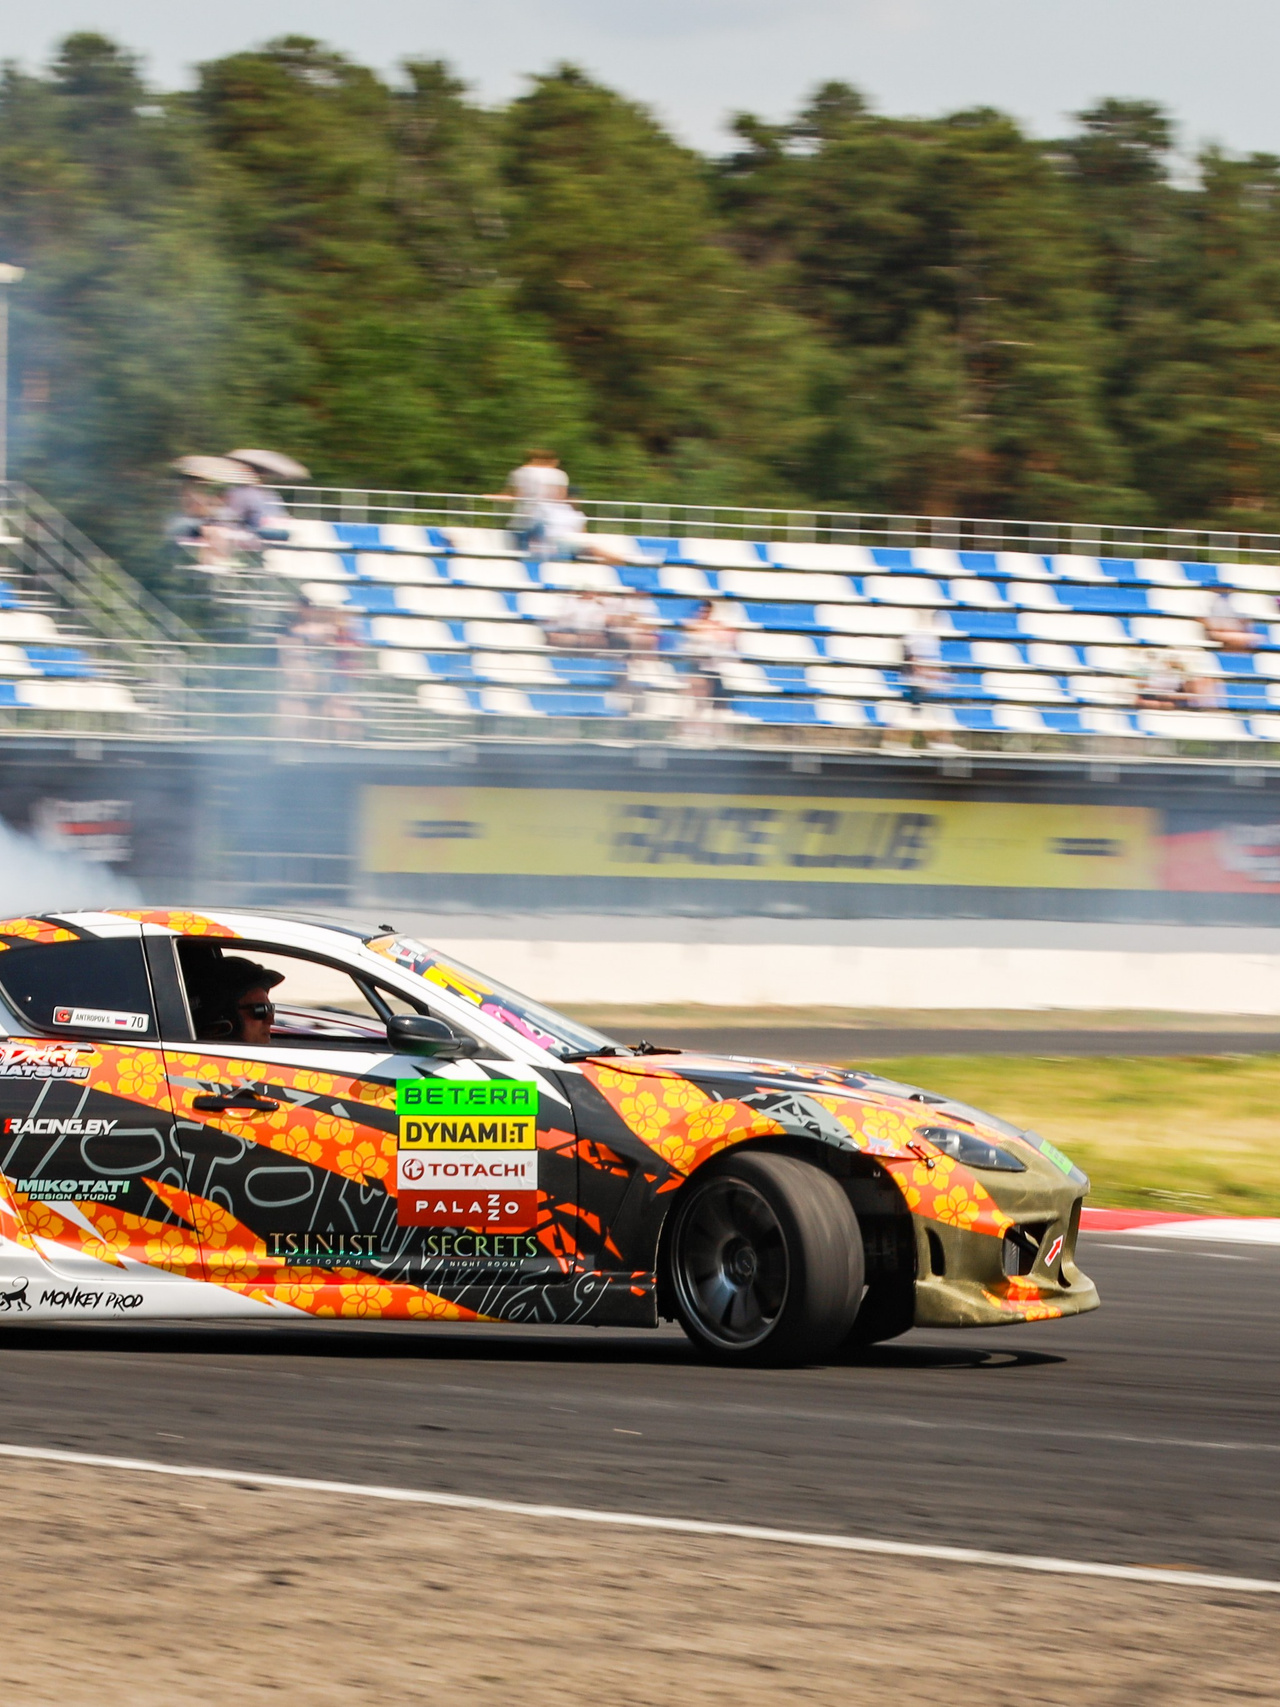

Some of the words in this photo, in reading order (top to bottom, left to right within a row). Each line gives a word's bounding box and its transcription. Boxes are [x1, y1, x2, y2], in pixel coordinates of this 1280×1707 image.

[608, 804, 782, 867] RACE
[786, 808, 940, 870] CLUB
[75, 1013, 107, 1023] ANTROPOV
[130, 1016, 144, 1029] 70
[428, 1163, 526, 1177] TOTACHI
[16, 1180, 130, 1194] MIKOTATI
[29, 1193, 72, 1201] DESIGN
[74, 1193, 117, 1201] STUDIO
[269, 1232, 378, 1257] TSINIST
[427, 1235, 538, 1258] SECRETS
[449, 1260, 481, 1268] NIGHT
[487, 1260, 517, 1268] ROOM
[39, 1286, 104, 1309] MONKEY
[105, 1293, 144, 1310] PROD
